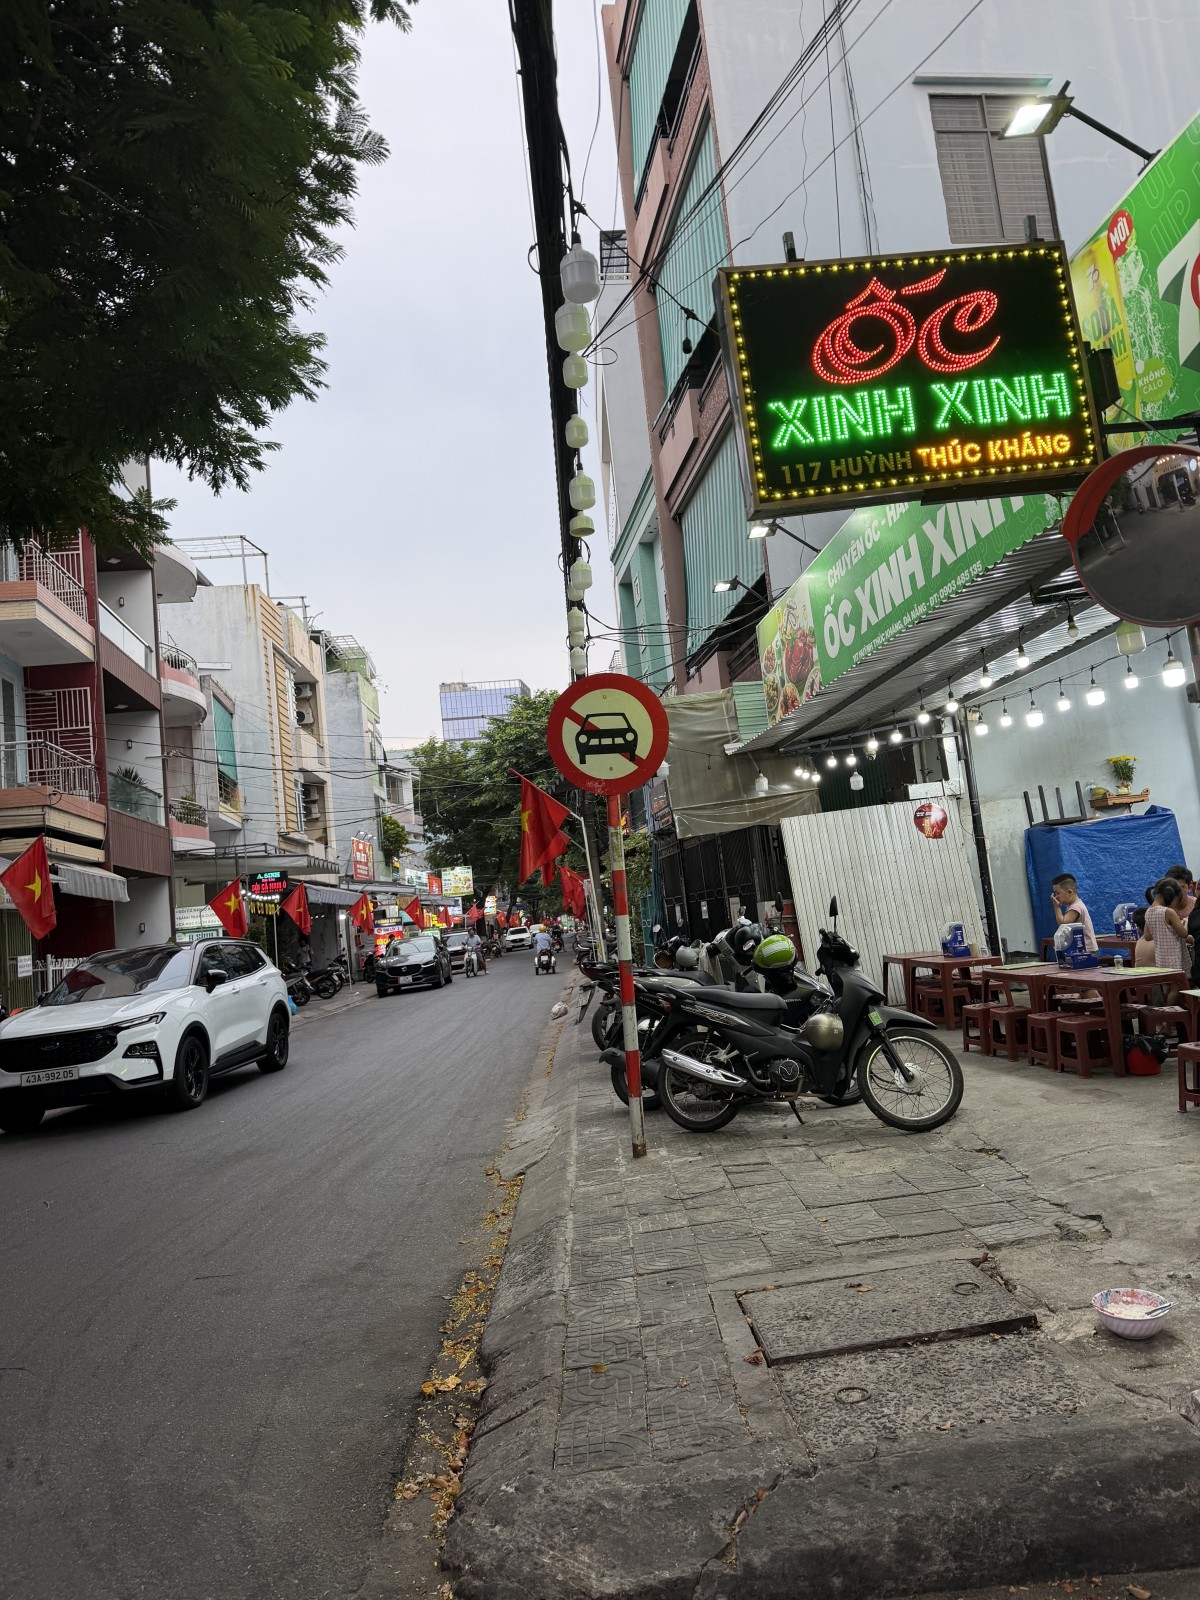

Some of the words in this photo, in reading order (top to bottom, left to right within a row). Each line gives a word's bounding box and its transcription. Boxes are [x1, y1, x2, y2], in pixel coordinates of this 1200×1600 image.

[1110, 216, 1130, 251] MỚI
[1082, 297, 1122, 341] SODA
[1138, 367, 1166, 388] KHÔNG
[1143, 379, 1164, 396] CALO
[769, 387, 916, 448] XINH
[931, 372, 1072, 429] XINH
[780, 462, 821, 485] 117
[830, 448, 912, 480] HUỲNH
[917, 437, 981, 469] THÚC
[988, 431, 1071, 462] KHÁNG
[827, 537, 865, 589] CHUYÊN
[939, 580, 957, 599] 0903
[956, 570, 970, 588] 485
[969, 561, 983, 579] 135
[822, 594, 855, 658] ỐC
[854, 533, 926, 635] XINH
[25, 1070, 74, 1083] 43A-992.05
